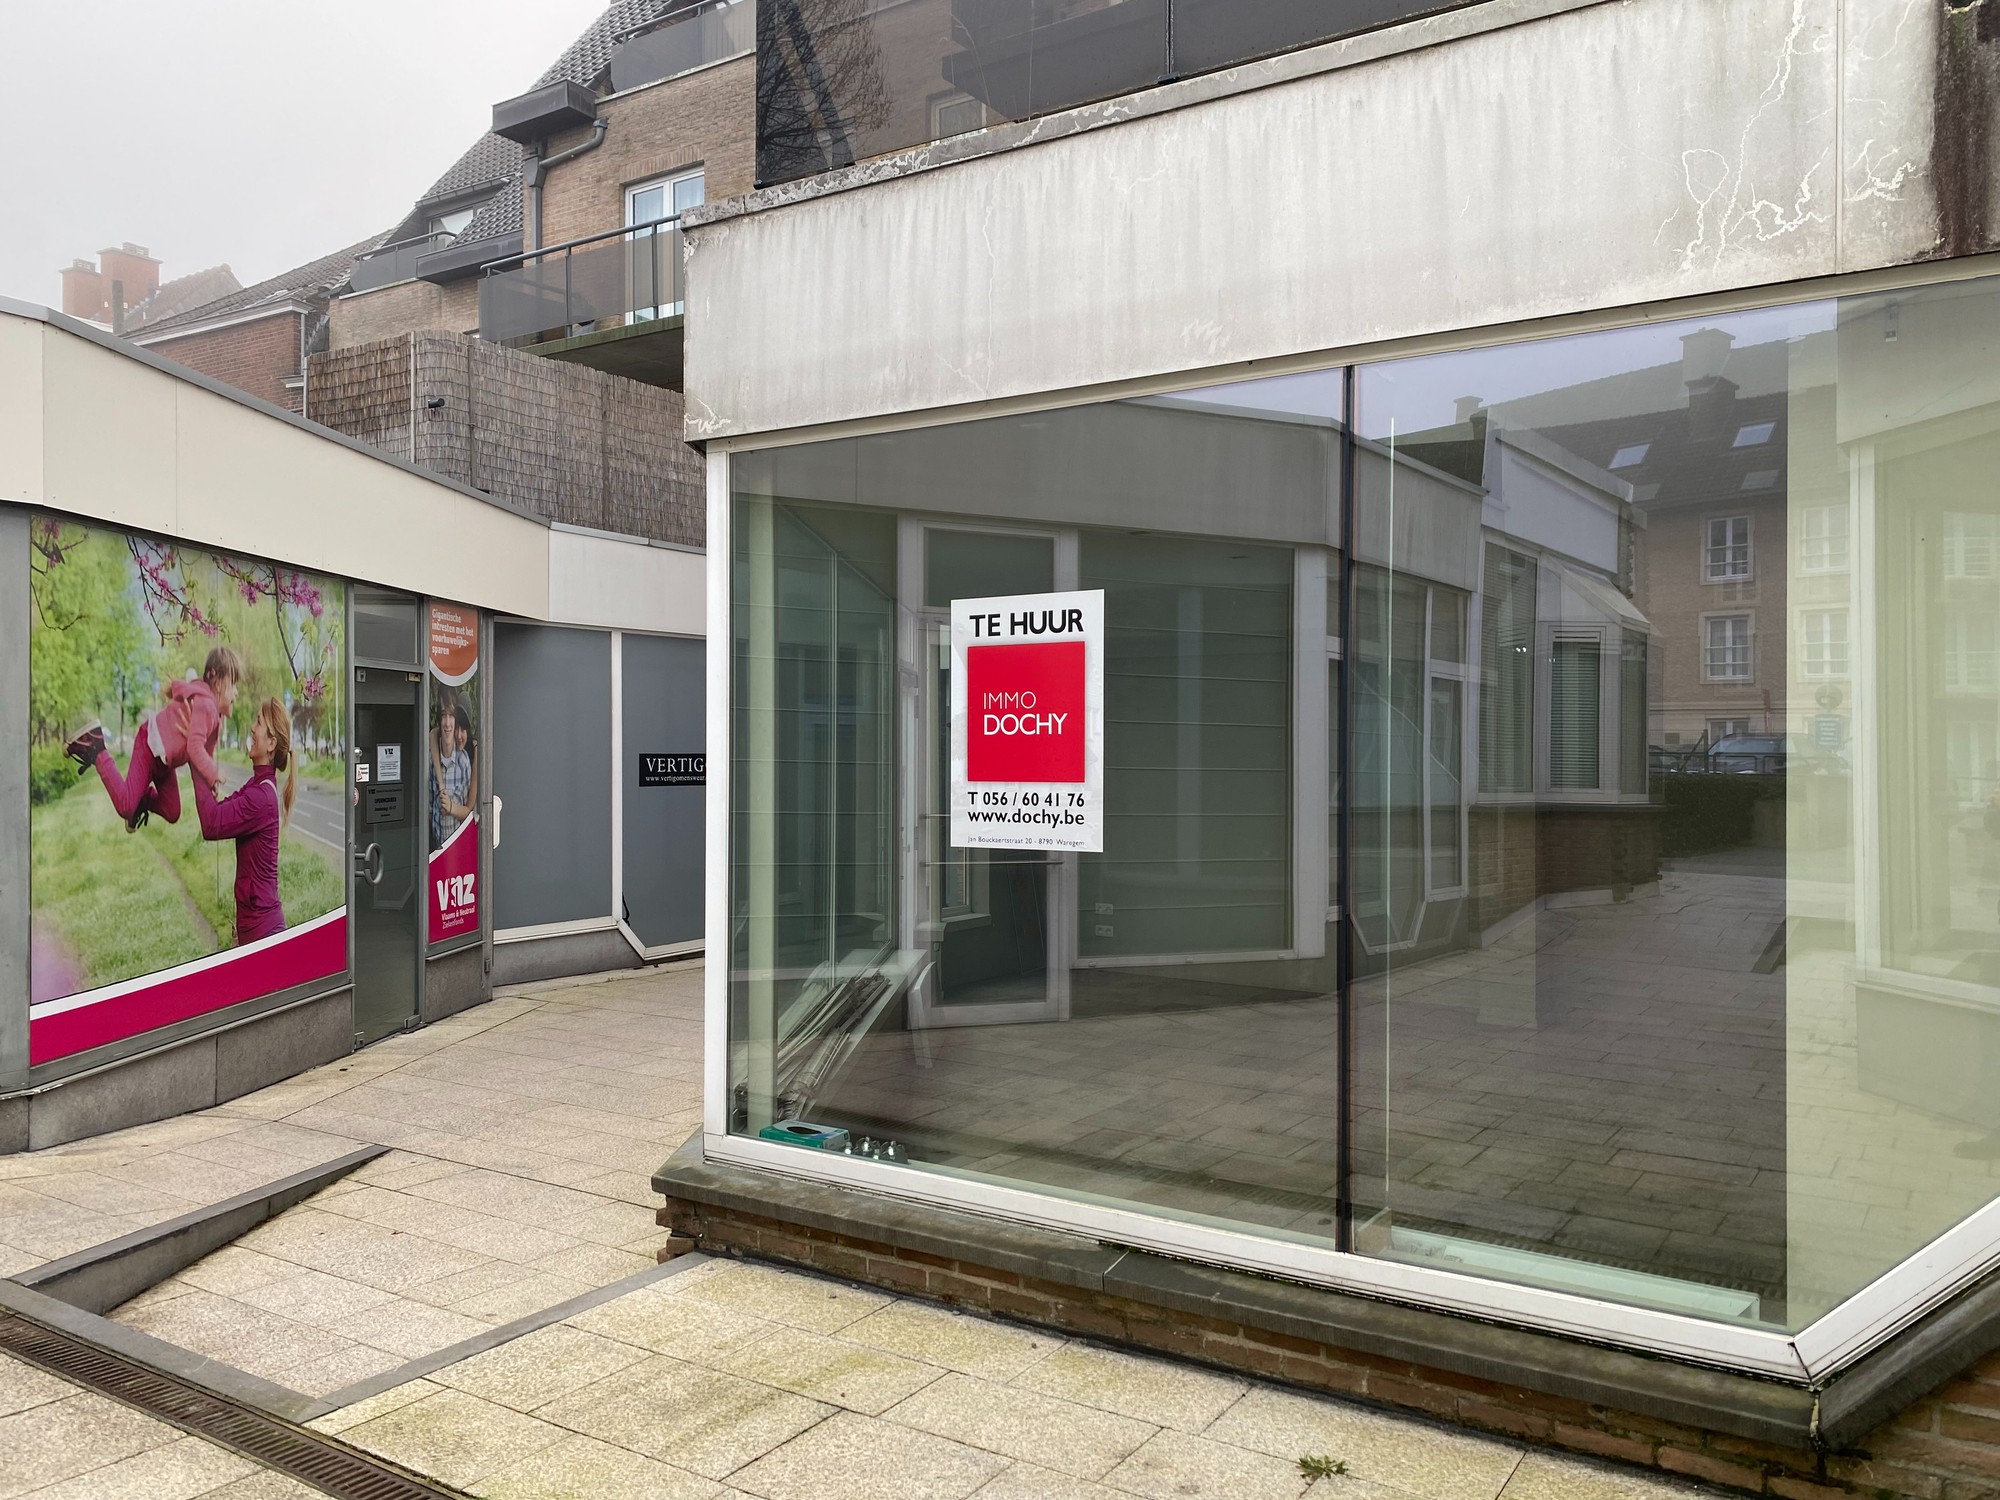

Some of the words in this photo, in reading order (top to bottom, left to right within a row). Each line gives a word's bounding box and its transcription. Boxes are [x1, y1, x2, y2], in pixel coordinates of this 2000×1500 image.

[432, 609, 462, 623] Gigantische
[969, 613, 1001, 638] TE
[1010, 608, 1084, 636] HUUR
[456, 626, 465, 635] met
[465, 626, 474, 637] het
[431, 645, 450, 656] sparen
[983, 691, 1037, 710] IMMO
[983, 713, 1068, 736] DOCHY
[645, 757, 706, 773] VERTIG
[967, 791, 979, 806] T
[982, 791, 1009, 806] 056
[1012, 791, 1018, 807] /
[1022, 792, 1040, 807] 60
[1044, 792, 1060, 807] 41
[1067, 792, 1085, 808] 76
[967, 808, 1085, 829] www.dochy.be
[967, 835, 977, 844] Jan
[1024, 837, 1034, 845] 20
[1038, 837, 1054, 846] 8790
